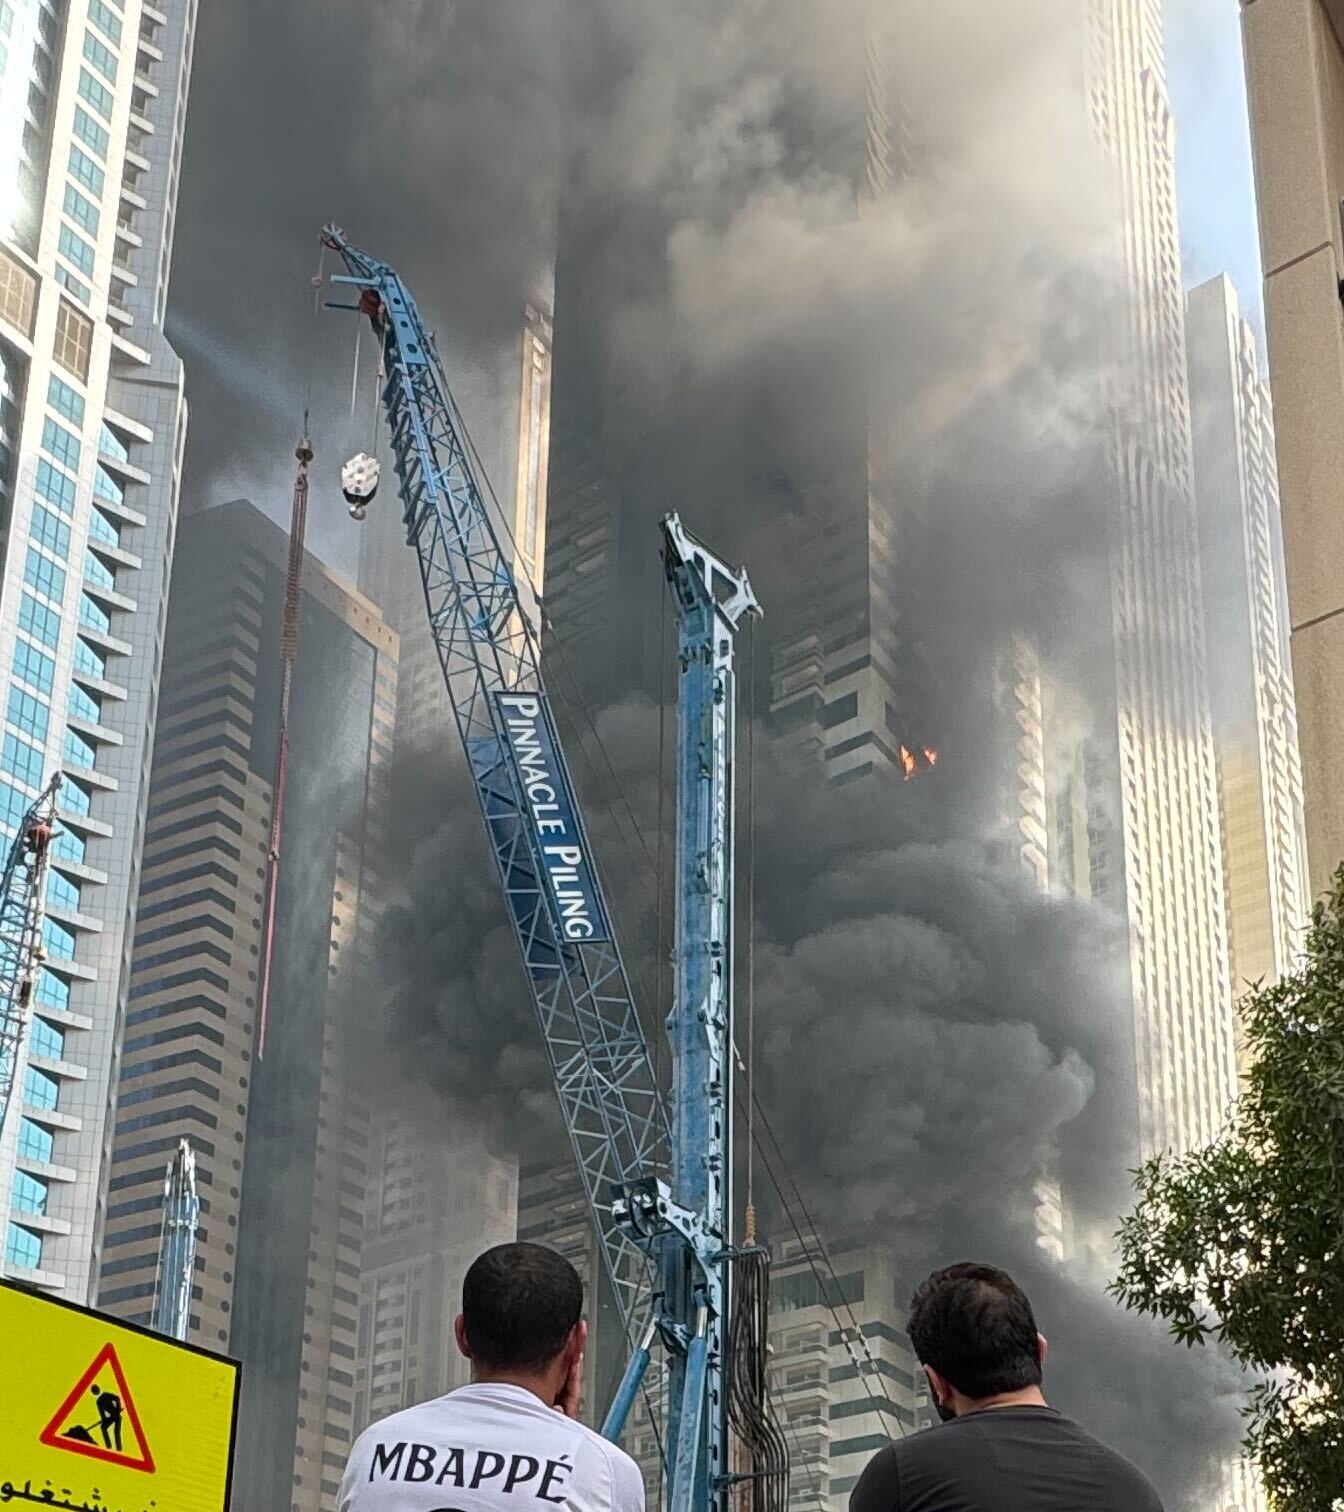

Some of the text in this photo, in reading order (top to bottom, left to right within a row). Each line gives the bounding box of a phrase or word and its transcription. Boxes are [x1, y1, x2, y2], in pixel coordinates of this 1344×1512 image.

[501, 696, 594, 939] PINNACLE PILING
[368, 1442, 574, 1503] MBAPPÉ
